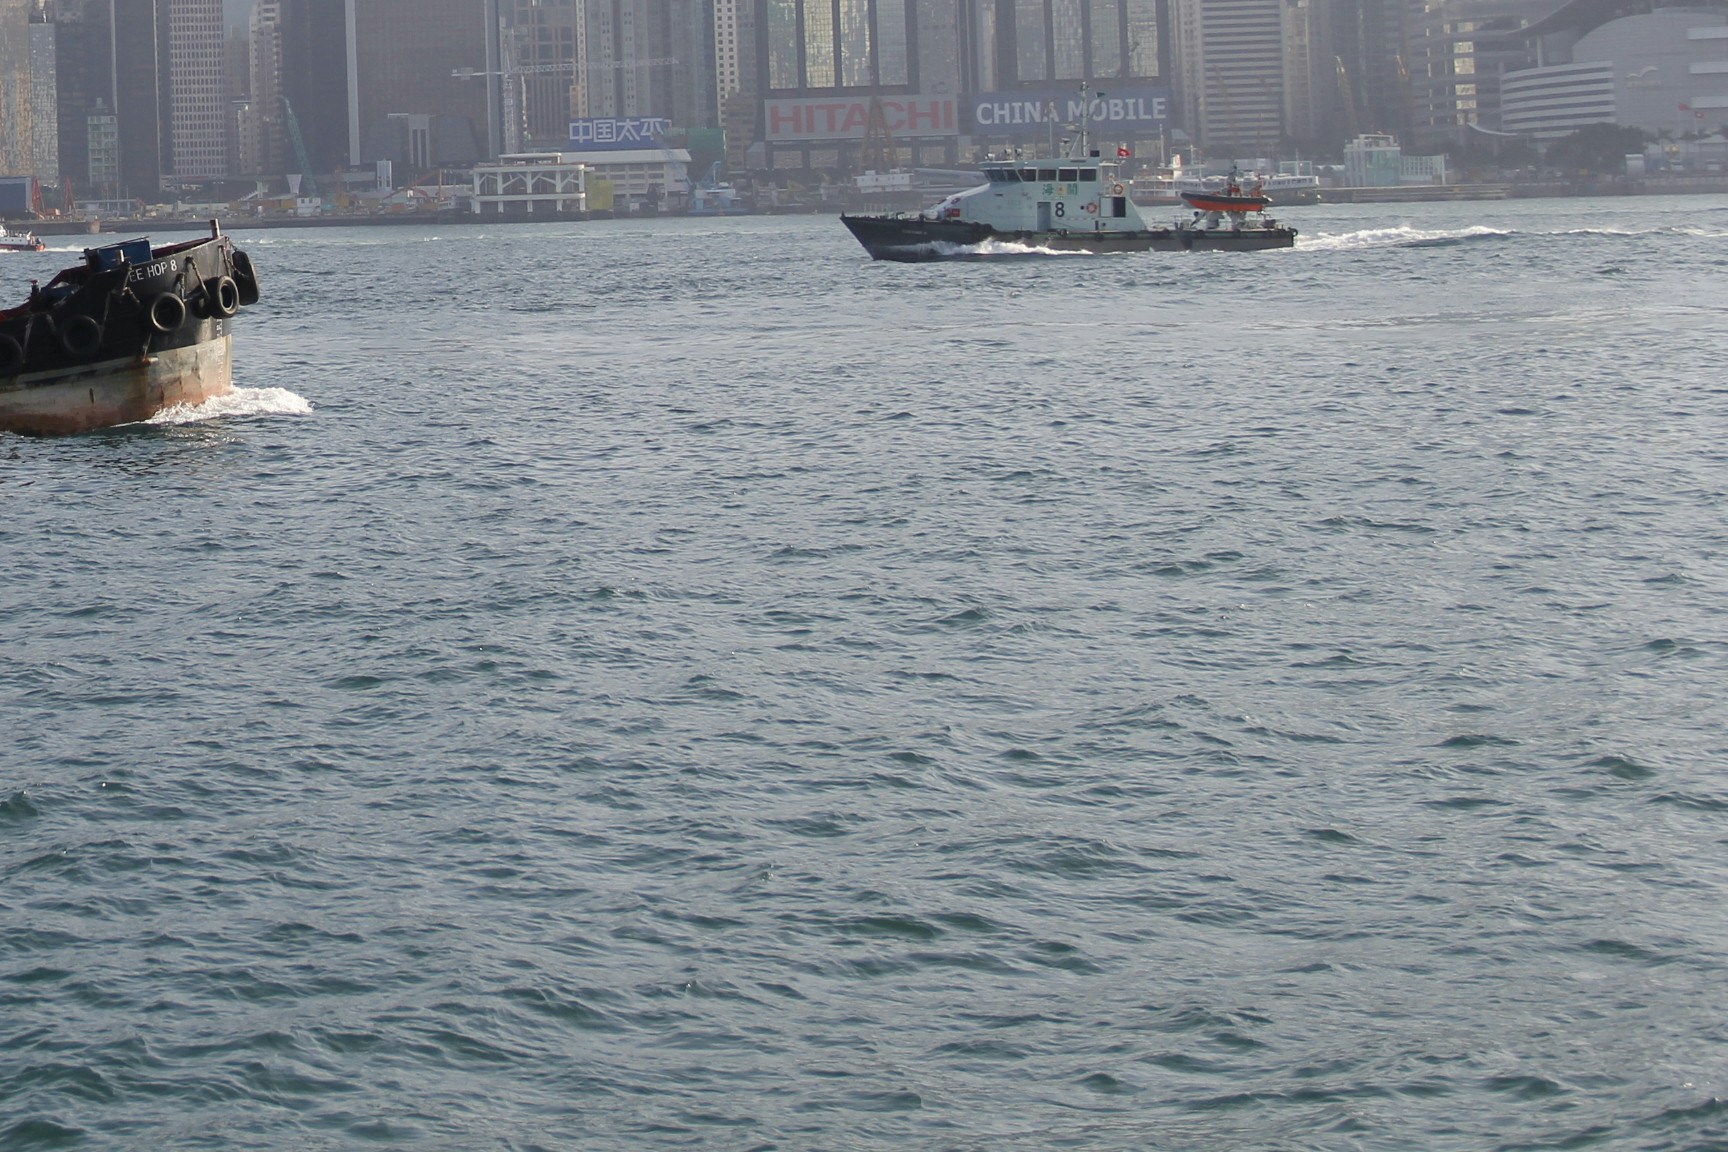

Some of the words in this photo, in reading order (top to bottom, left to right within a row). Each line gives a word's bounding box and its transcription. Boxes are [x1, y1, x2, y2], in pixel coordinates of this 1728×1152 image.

[770, 100, 953, 134] HITACHI
[976, 102, 1060, 125] CHINA
[1067, 97, 1167, 122] MOBILE
[1055, 202, 1065, 217] 8
[146, 261, 168, 278] HOP
[170, 259, 177, 272] 8
